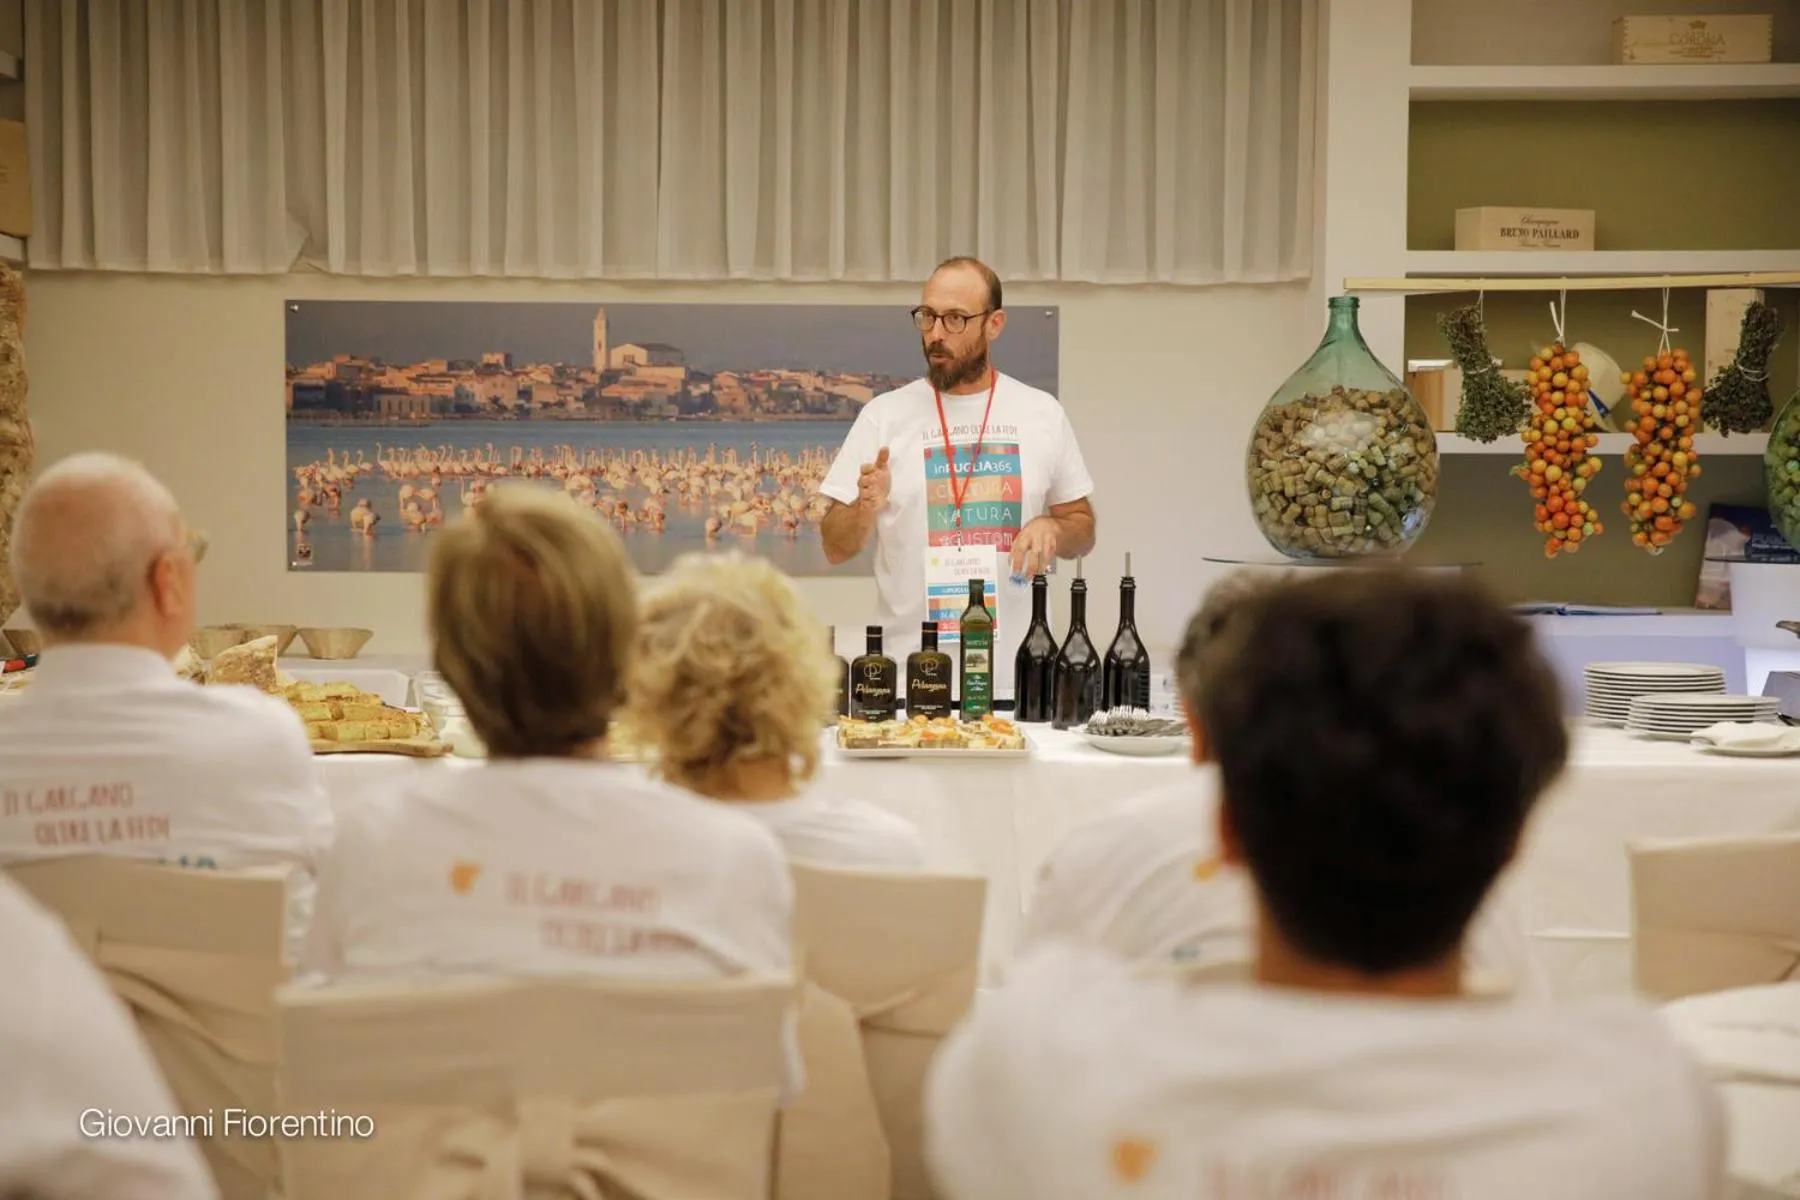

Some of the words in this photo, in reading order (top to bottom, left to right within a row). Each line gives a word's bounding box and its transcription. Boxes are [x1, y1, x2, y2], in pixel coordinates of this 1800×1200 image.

[1500, 227, 1529, 238] BRUNO
[1532, 228, 1580, 240] PAILLARD
[936, 507, 1013, 525] NATURA
